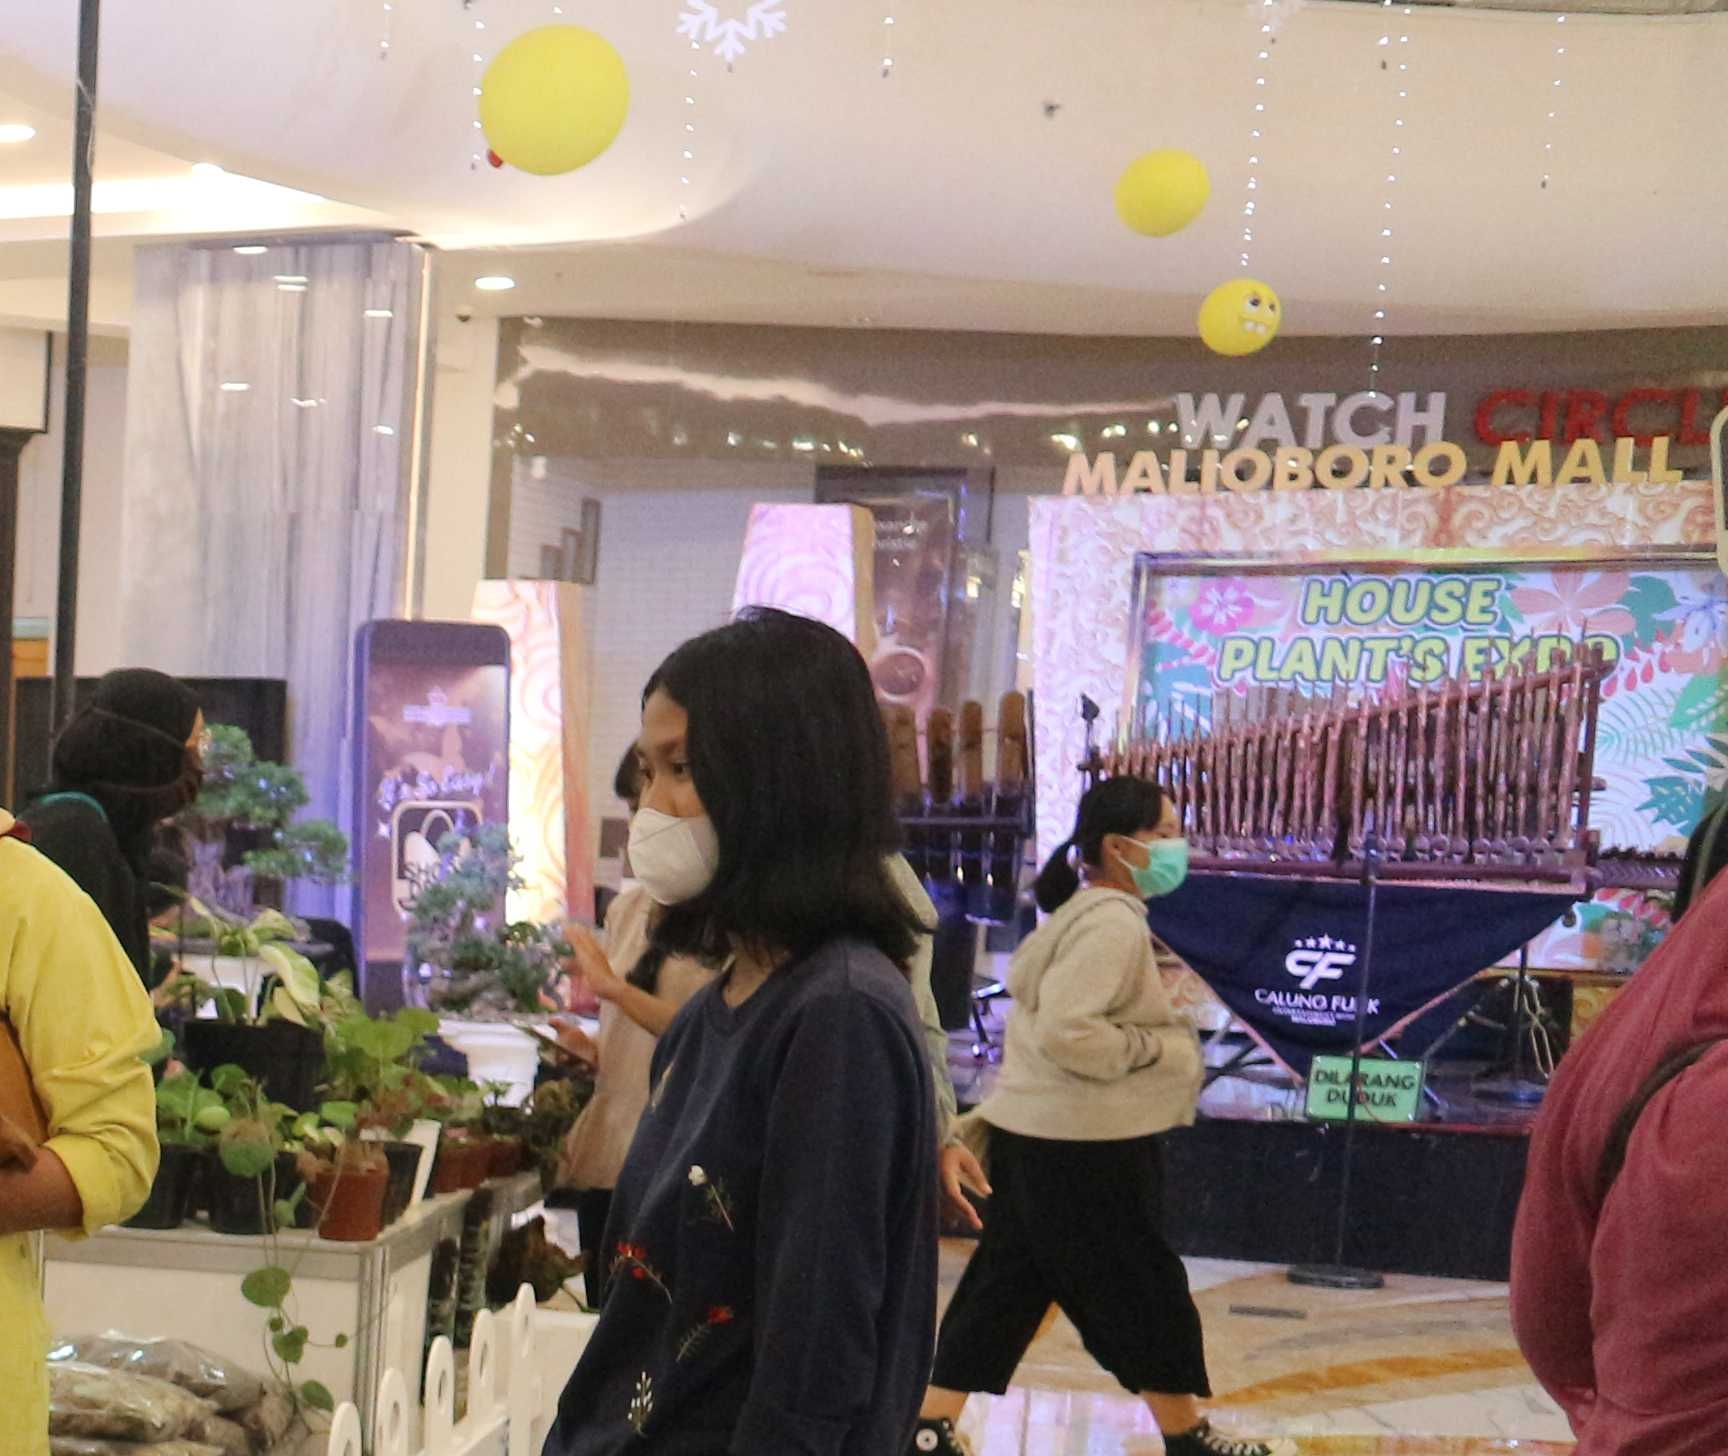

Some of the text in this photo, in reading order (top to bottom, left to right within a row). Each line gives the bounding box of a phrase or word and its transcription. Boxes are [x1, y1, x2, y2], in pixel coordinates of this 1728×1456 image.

[1176, 387, 1728, 450] WATCH CIRCL
[1062, 435, 1684, 497] MALIOBORO MALL
[1301, 577, 1503, 627] HOUSE
[1218, 635, 1450, 684] PLANT'S
[1331, 995, 1381, 1015] FUK
